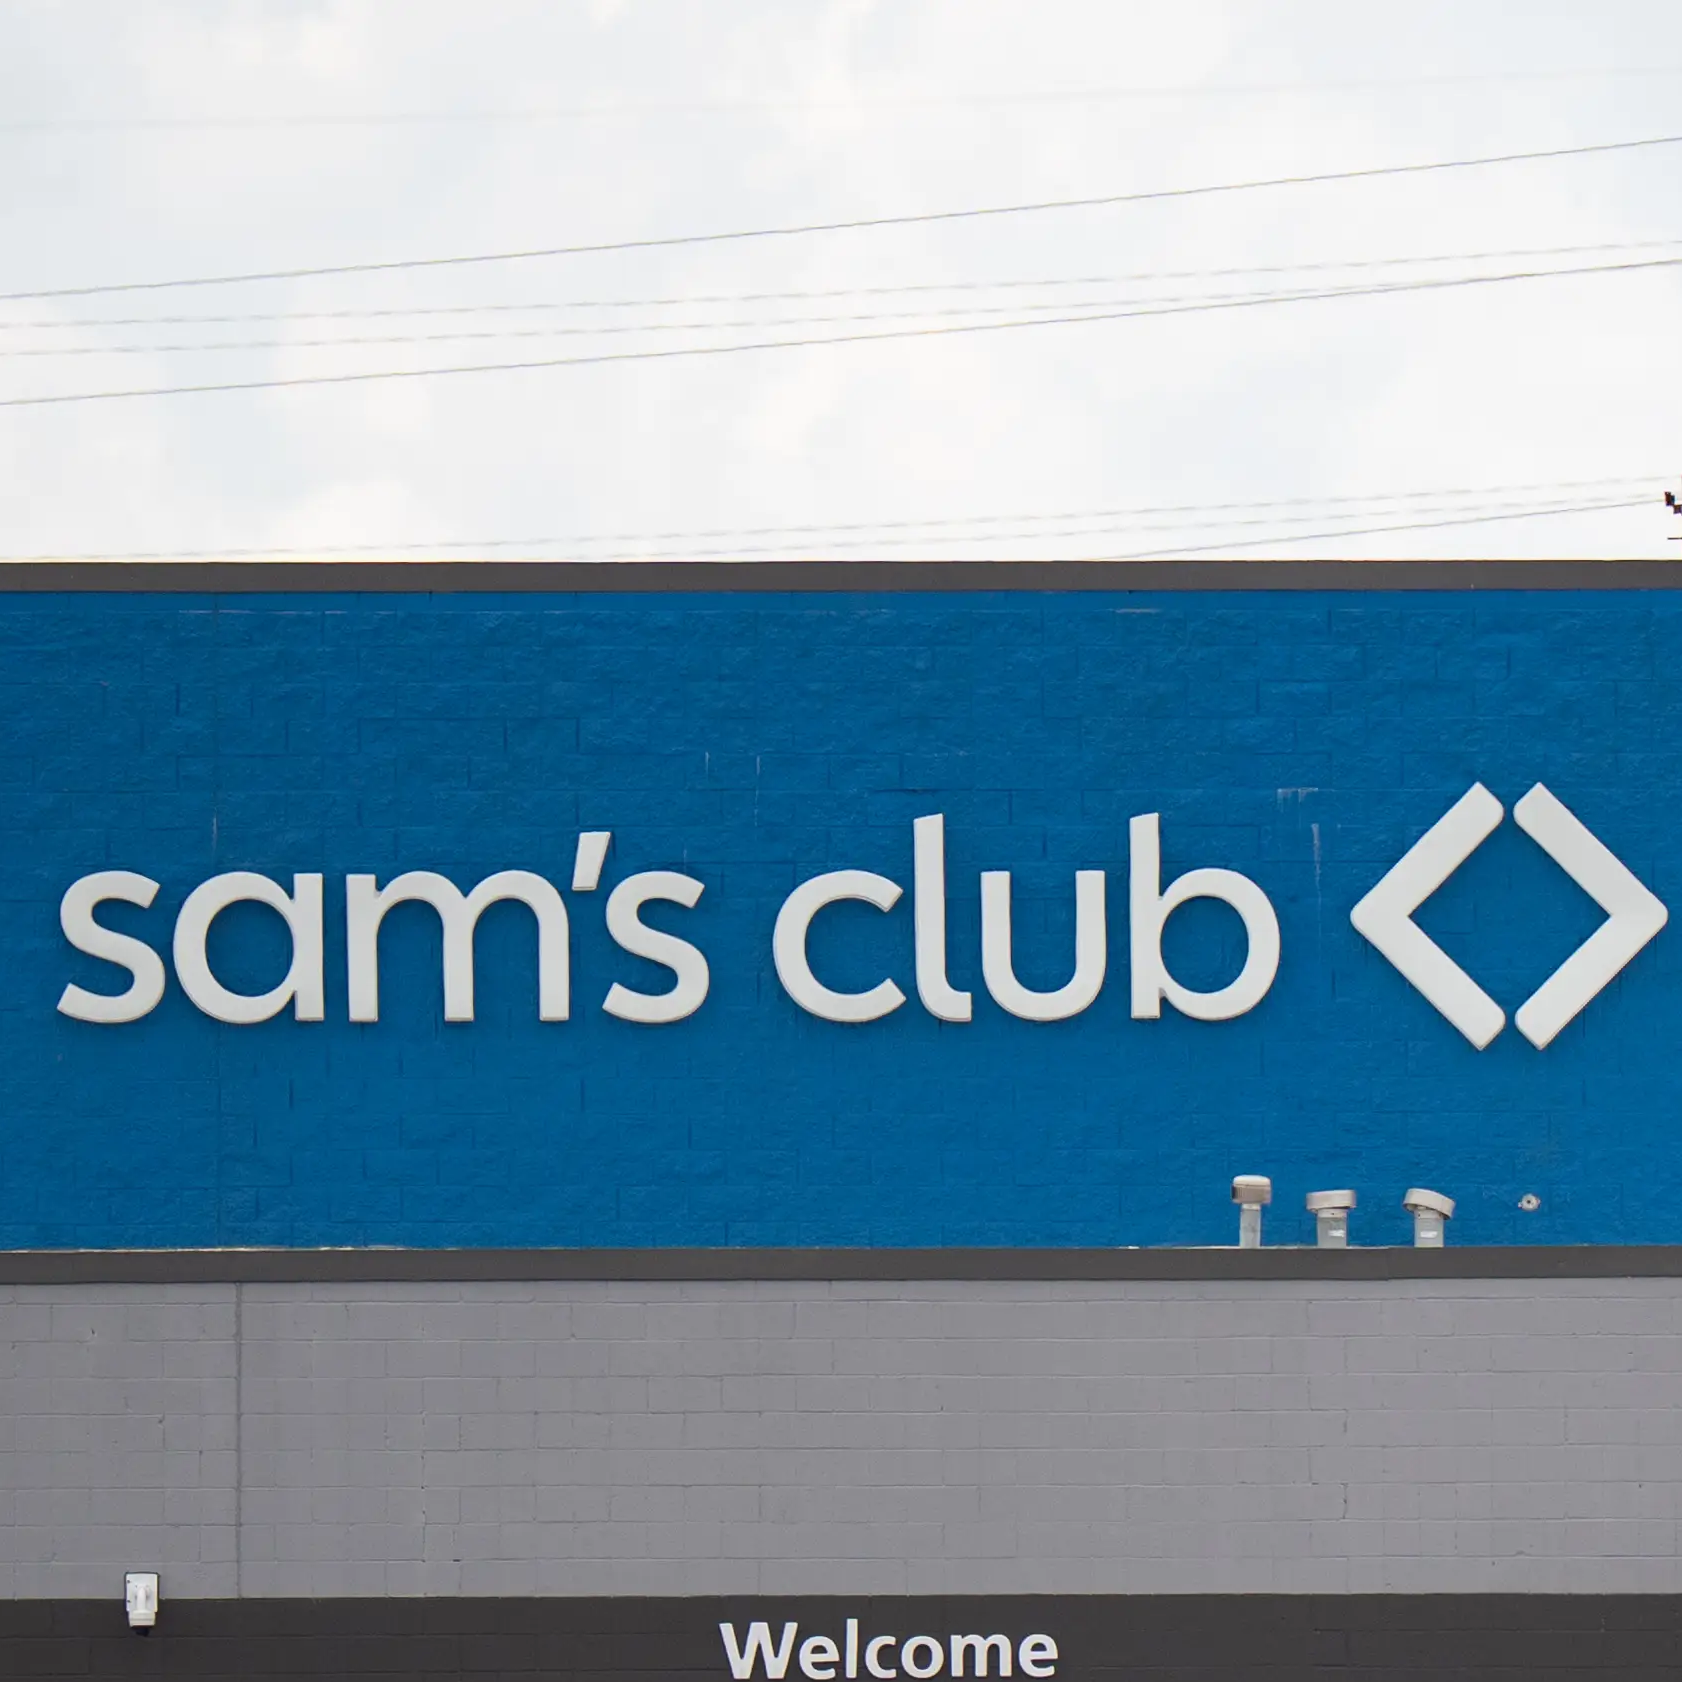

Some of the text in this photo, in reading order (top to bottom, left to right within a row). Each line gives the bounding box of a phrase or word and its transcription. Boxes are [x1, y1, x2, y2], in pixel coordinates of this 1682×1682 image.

[58, 811, 1283, 1023] sam's club
[718, 1617, 1059, 1681] Welcome
